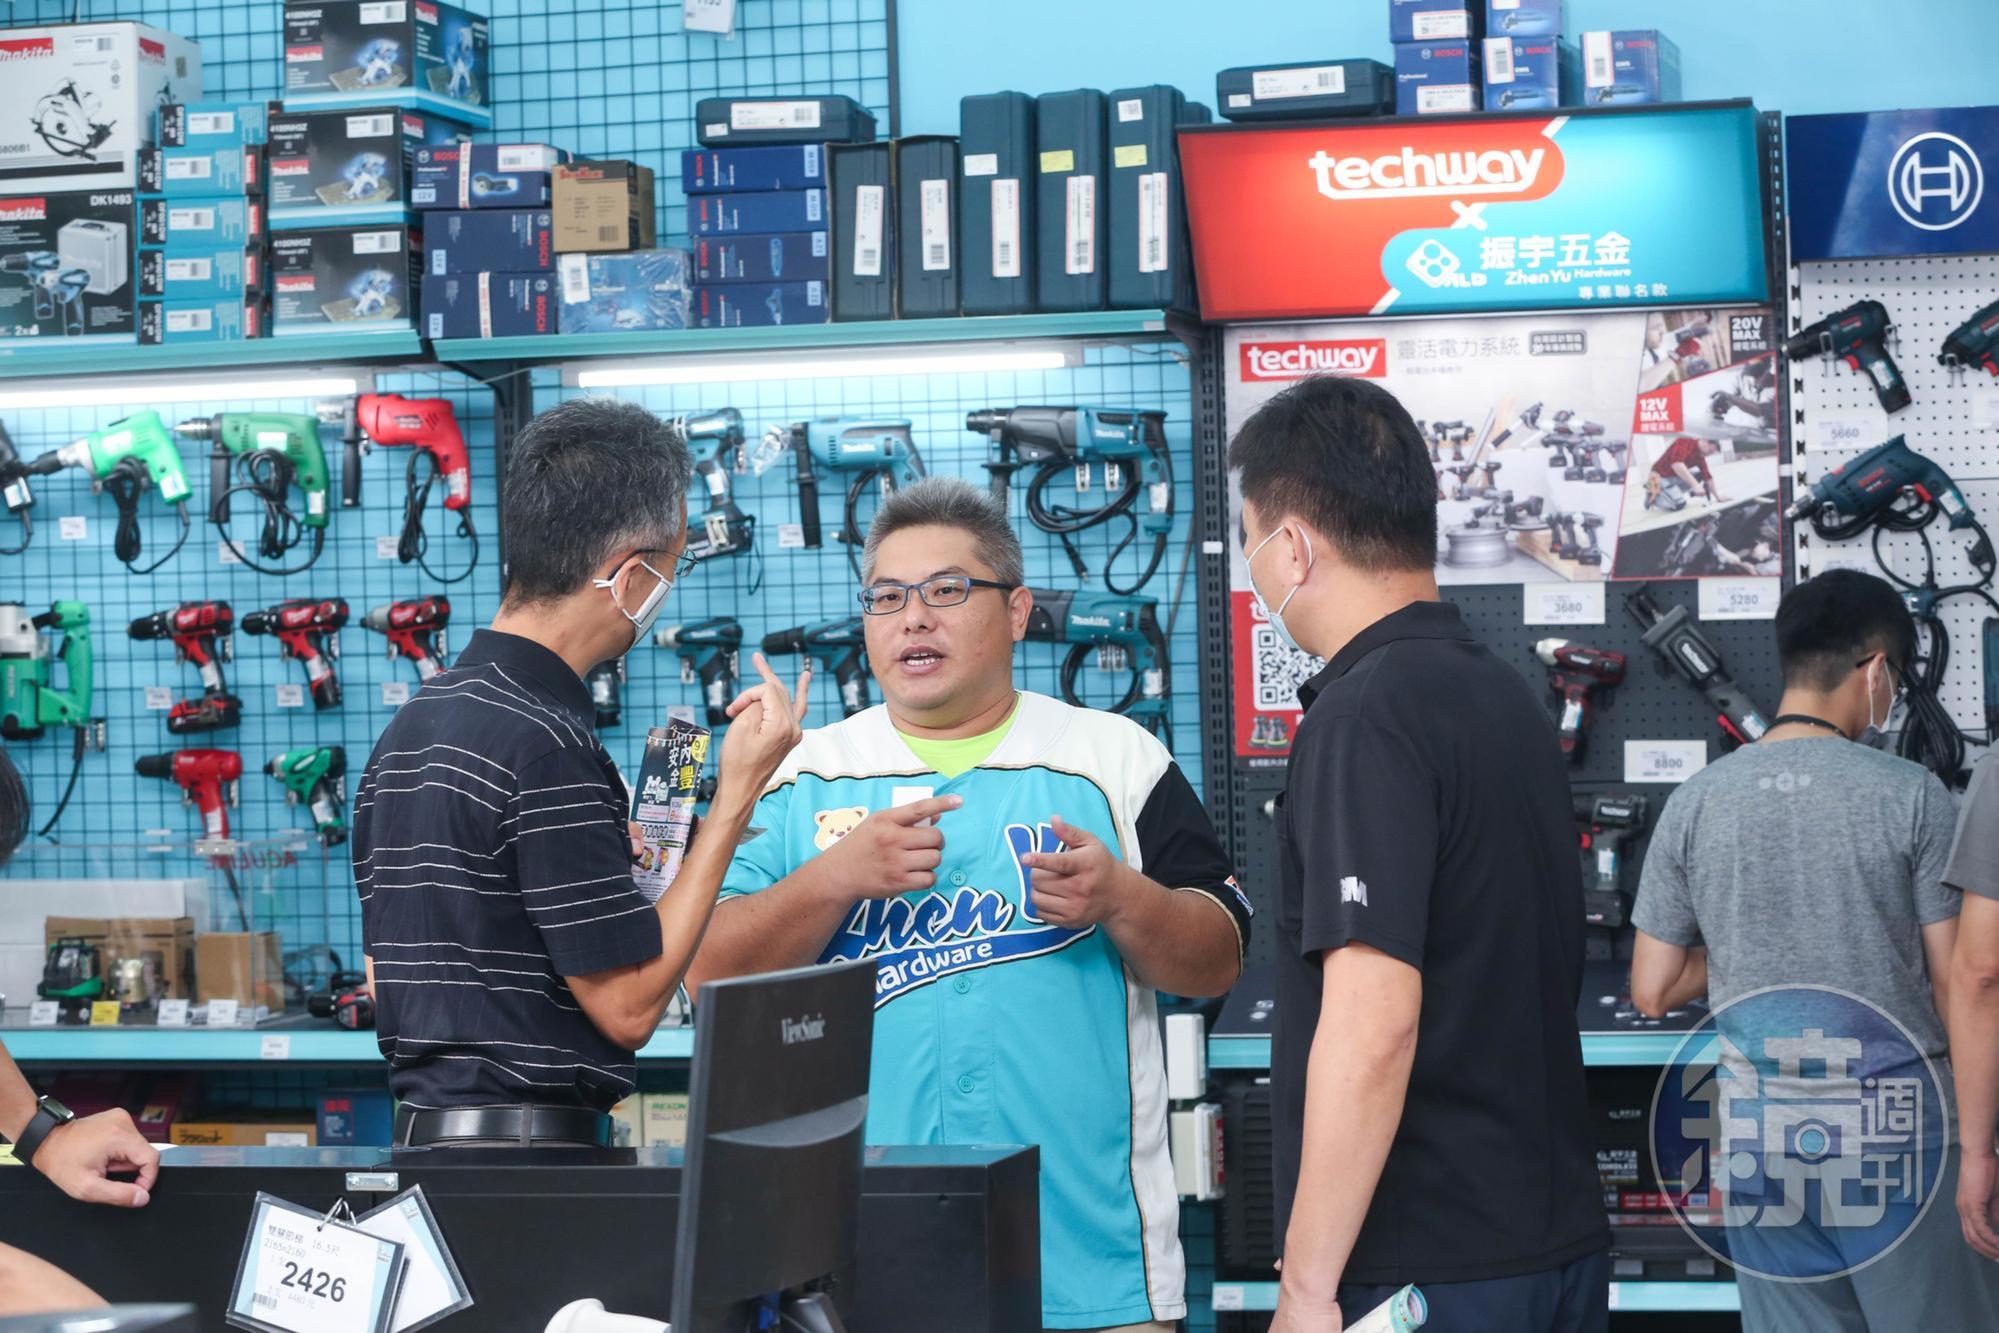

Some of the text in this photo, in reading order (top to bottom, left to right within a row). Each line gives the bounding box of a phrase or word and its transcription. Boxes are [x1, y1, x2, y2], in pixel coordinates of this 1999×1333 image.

[433, 151, 461, 162] BOSC
[1309, 147, 1544, 199] techway
[90, 194, 133, 206] DK1493
[539, 230, 548, 266] BOSCH
[1480, 231, 1631, 270] 振宇五金
[1505, 268, 1631, 286] Zhen Yu Hardware
[536, 295, 546, 332] BOSCH
[1731, 316, 1763, 330] 20V
[1732, 330, 1760, 340] MAX
[1397, 336, 1522, 360] 靈活電力系統
[1247, 344, 1378, 377] techway
[1640, 398, 1668, 411] 12V
[1641, 411, 1669, 421] MAX
[1831, 428, 1860, 439] 5660
[1071, 615, 1111, 627] Makita
[281, 1262, 346, 1302] 2426
